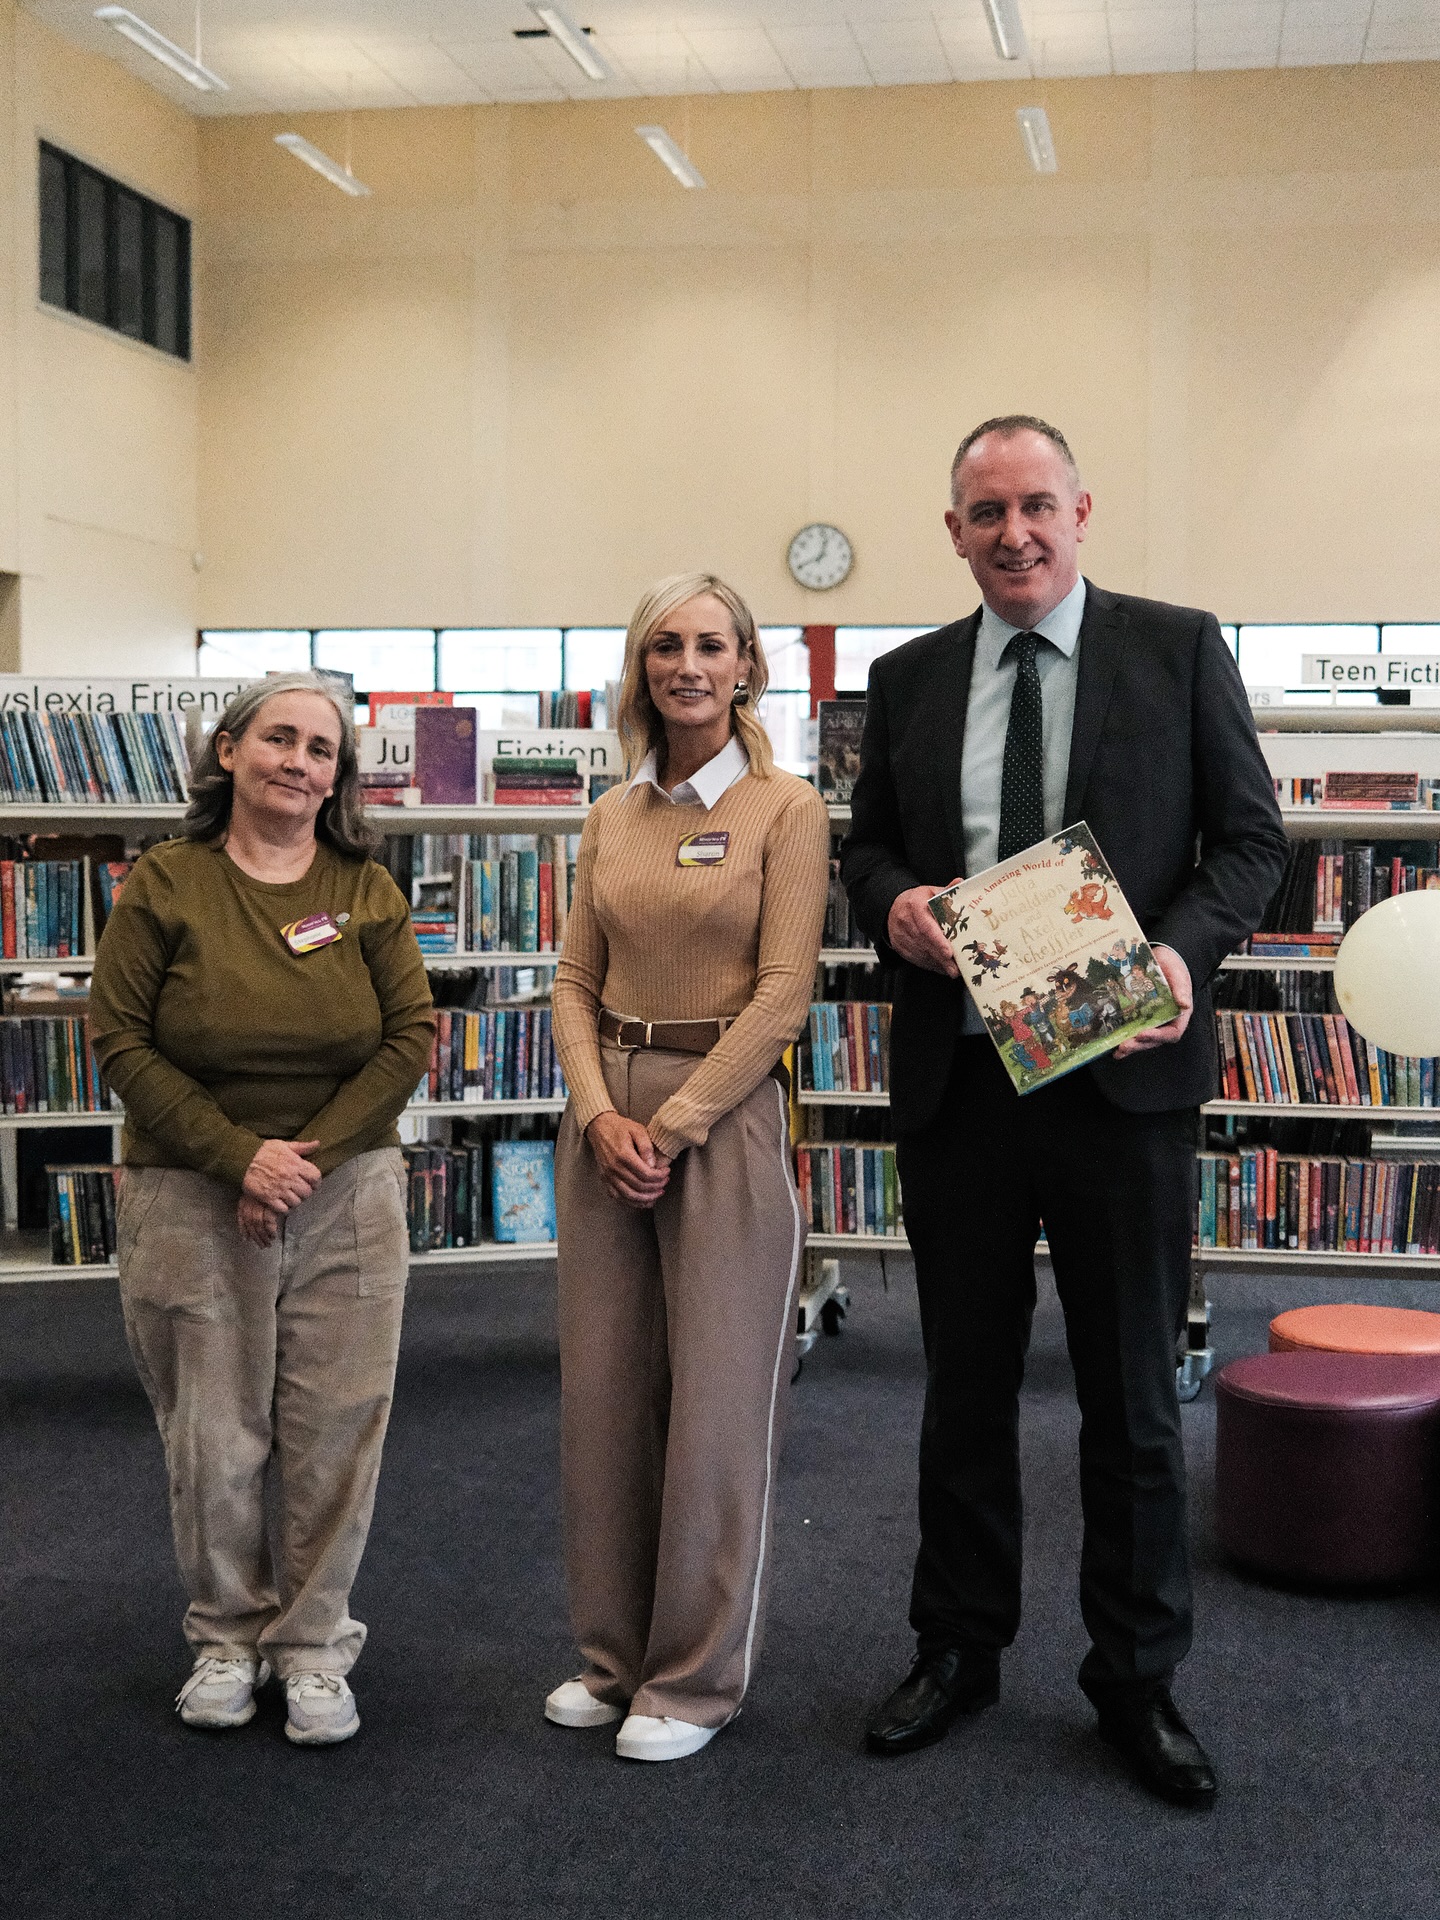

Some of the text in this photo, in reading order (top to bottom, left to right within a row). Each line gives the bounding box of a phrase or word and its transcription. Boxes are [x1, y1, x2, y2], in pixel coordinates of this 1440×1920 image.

[1315, 659, 1439, 684] Teen Ficti
[967, 858, 1066, 910] The Amazing World of
[1000, 878, 1037, 907] Julia
[987, 882, 1068, 931] Donaldson
[1012, 926, 1085, 969] Scheffler
[1019, 917, 1056, 945] Axel
